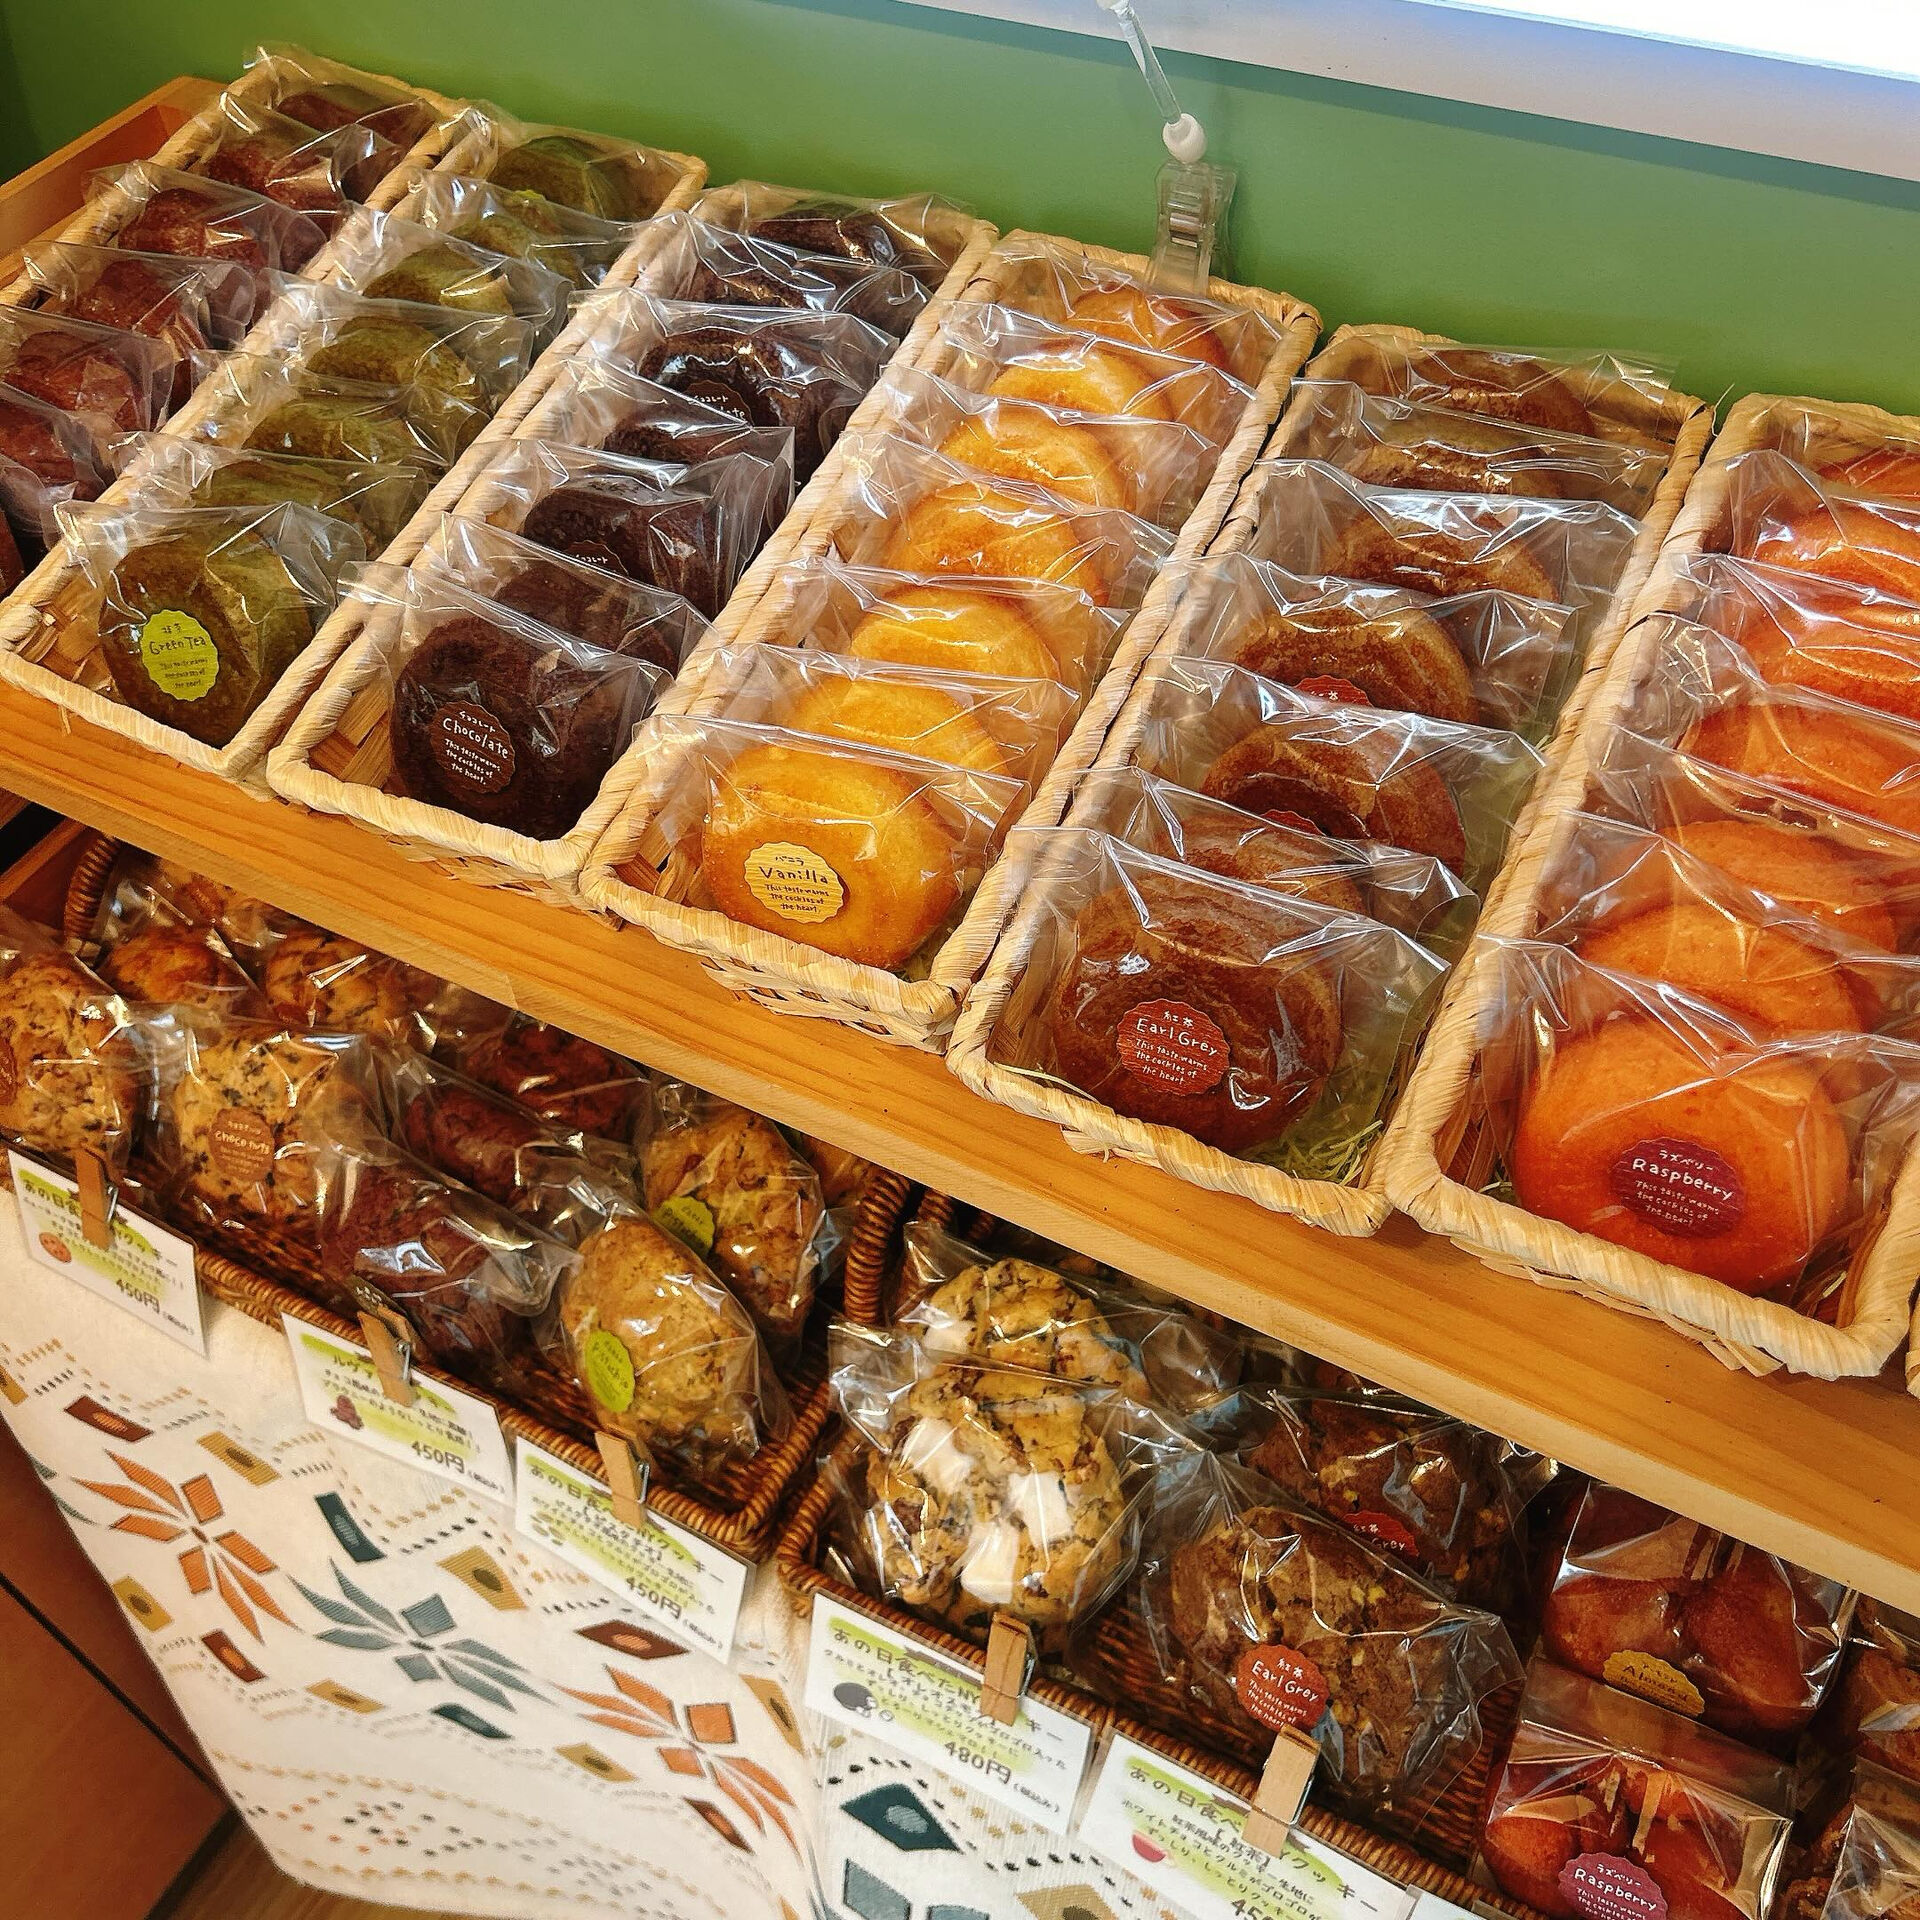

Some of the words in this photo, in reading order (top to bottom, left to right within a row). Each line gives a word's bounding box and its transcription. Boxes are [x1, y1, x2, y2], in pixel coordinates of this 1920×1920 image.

[149, 640, 184, 655] Green
[184, 636, 207, 650] Tea
[459, 710, 496, 733] チョコレート
[442, 717, 509, 759] Chocolate
[775, 855, 804, 866] バニラ
[759, 866, 828, 884] Vanilla
[1163, 1010, 1195, 1029] 紅茶
[1136, 1018, 1174, 1039] Earl
[1178, 1031, 1218, 1056] Grey
[1136, 1038, 1154, 1051] This
[1157, 1045, 1179, 1059] taste
[1180, 1056, 1208, 1071] warms
[1136, 1051, 1150, 1062] the
[1152, 1056, 1185, 1074] cockles
[1187, 1070, 1197, 1079] of
[1142, 1065, 1157, 1075] the
[1659, 1149, 1714, 1171] ラズベリー
[1632, 1158, 1733, 1200] Raspberry
[1635, 1180, 1657, 1192] This
[411, 1440, 465, 1475] 450円
[625, 1576, 683, 1620] 450円
[1276, 1657, 1304, 1680] 紅茶
[1251, 1660, 1284, 1688] Earl
[1285, 1680, 1319, 1703] Grey
[945, 1741, 1012, 1785] 480円
[1597, 1863, 1641, 1886] ラズベリー
[1574, 1868, 1657, 1911] Raspberry
[1576, 1887, 1594, 1899] This
